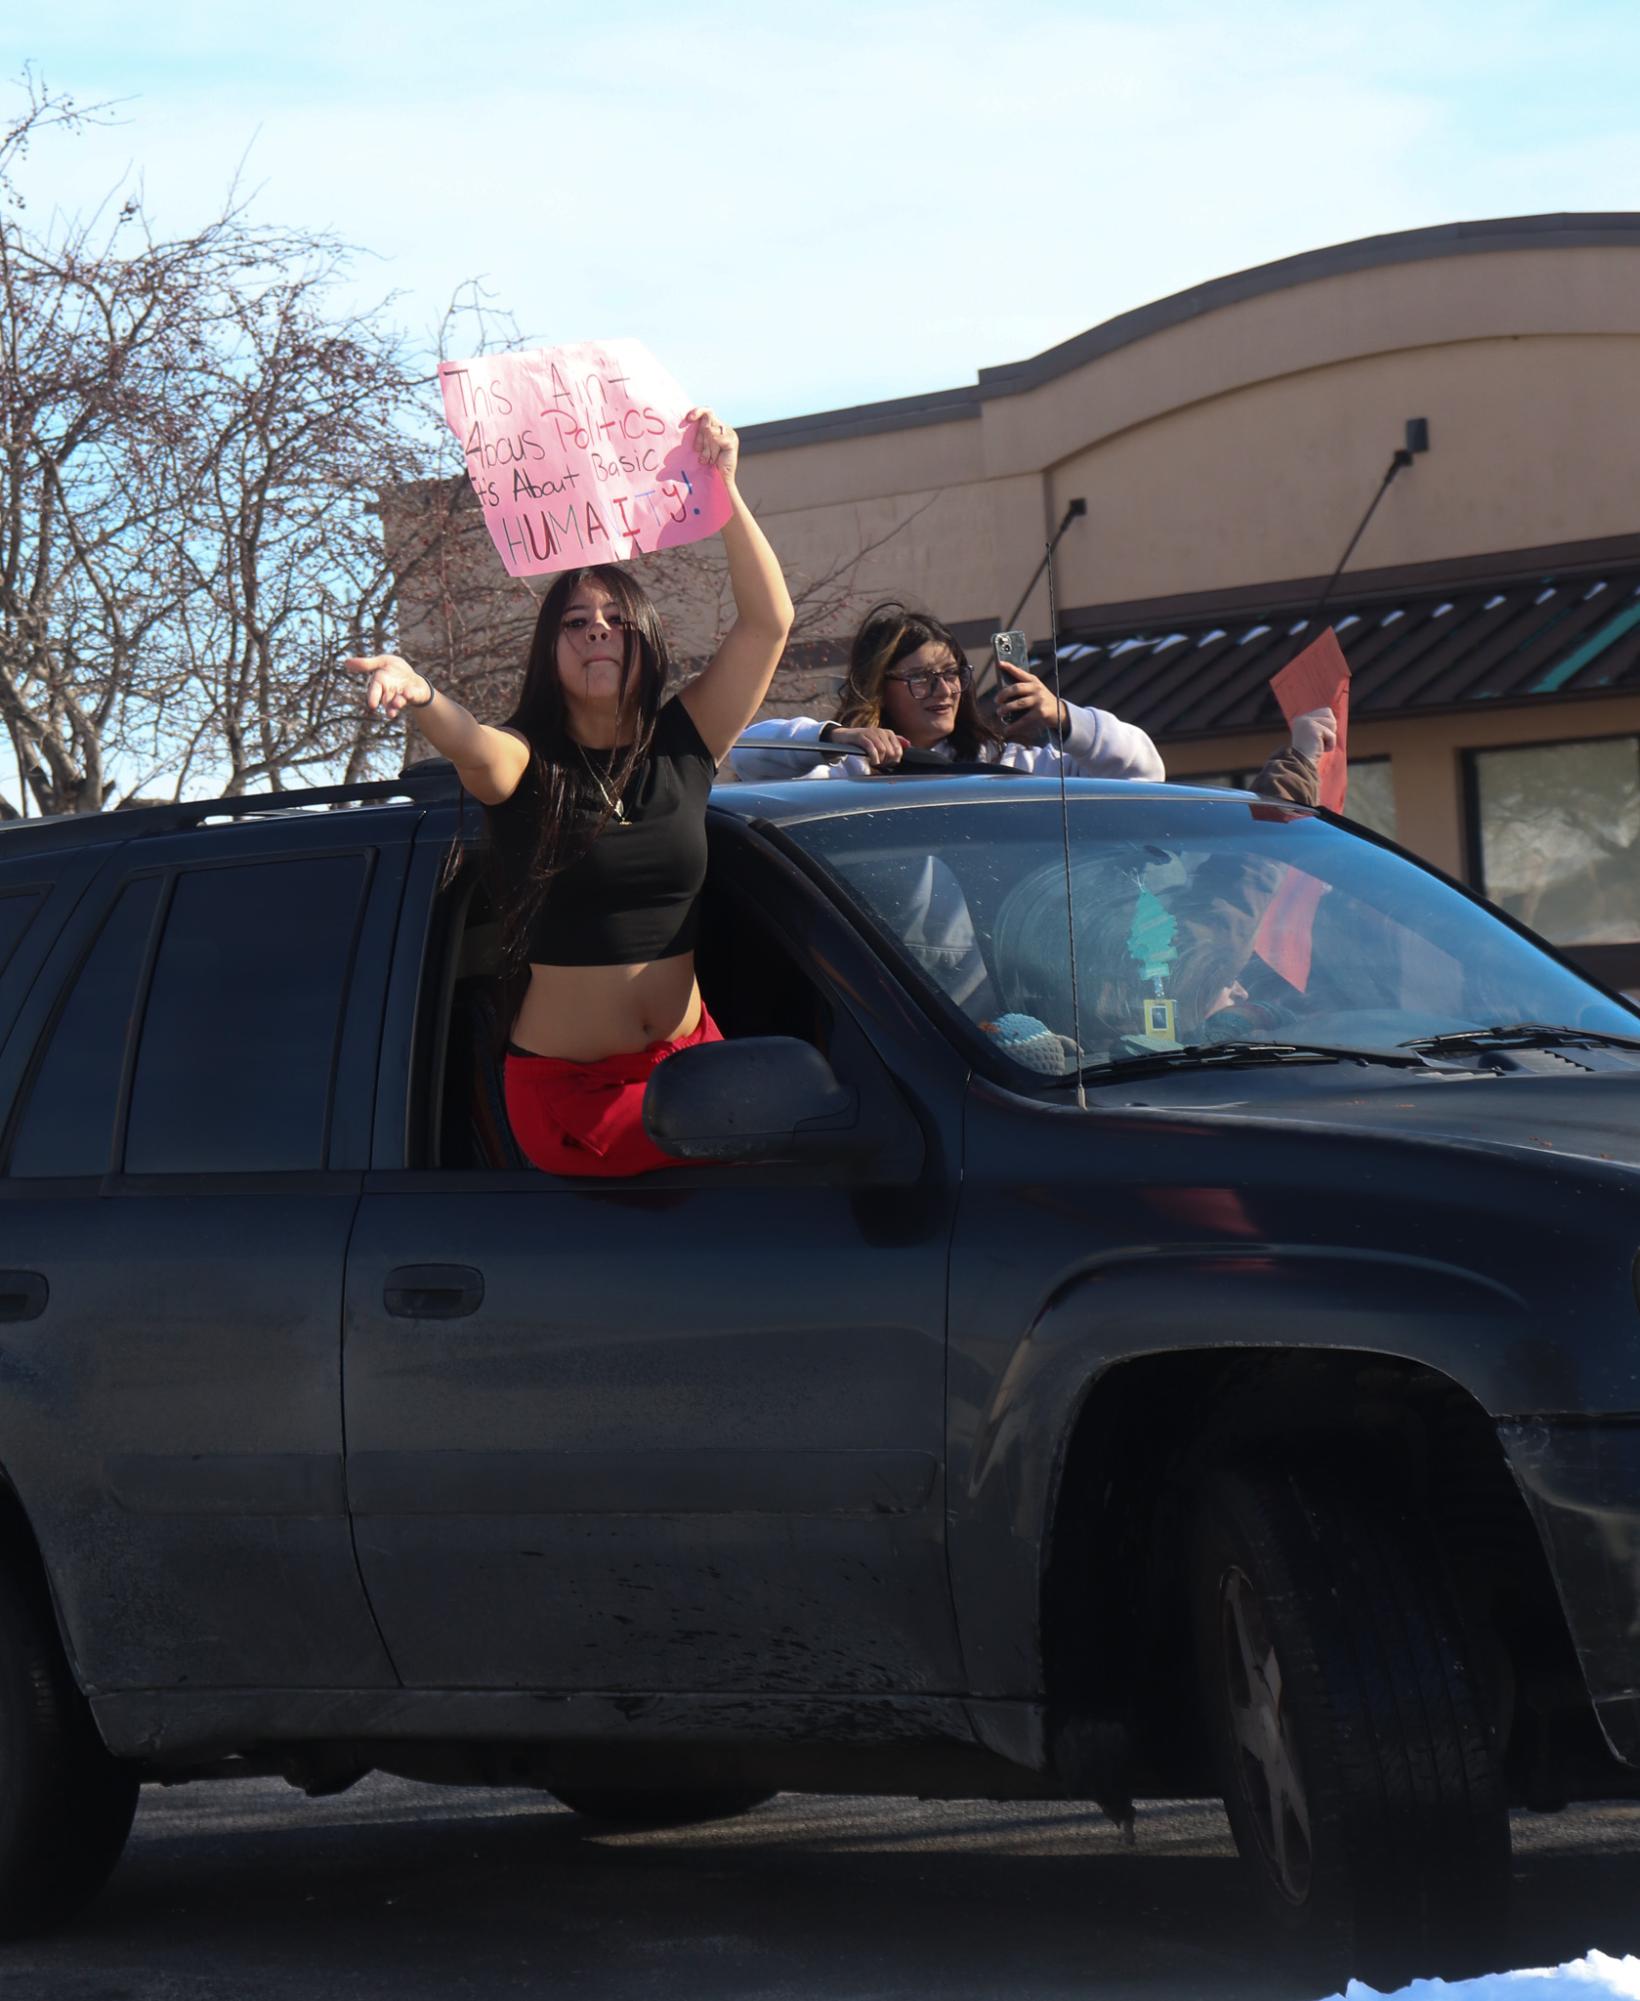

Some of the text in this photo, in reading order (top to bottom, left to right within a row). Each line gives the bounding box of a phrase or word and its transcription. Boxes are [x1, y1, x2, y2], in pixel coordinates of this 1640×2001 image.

[541, 406, 666, 454] Politics
[512, 464, 581, 503] About
[591, 448, 660, 482] Basic
[502, 470, 702, 566] HUMAITY!
